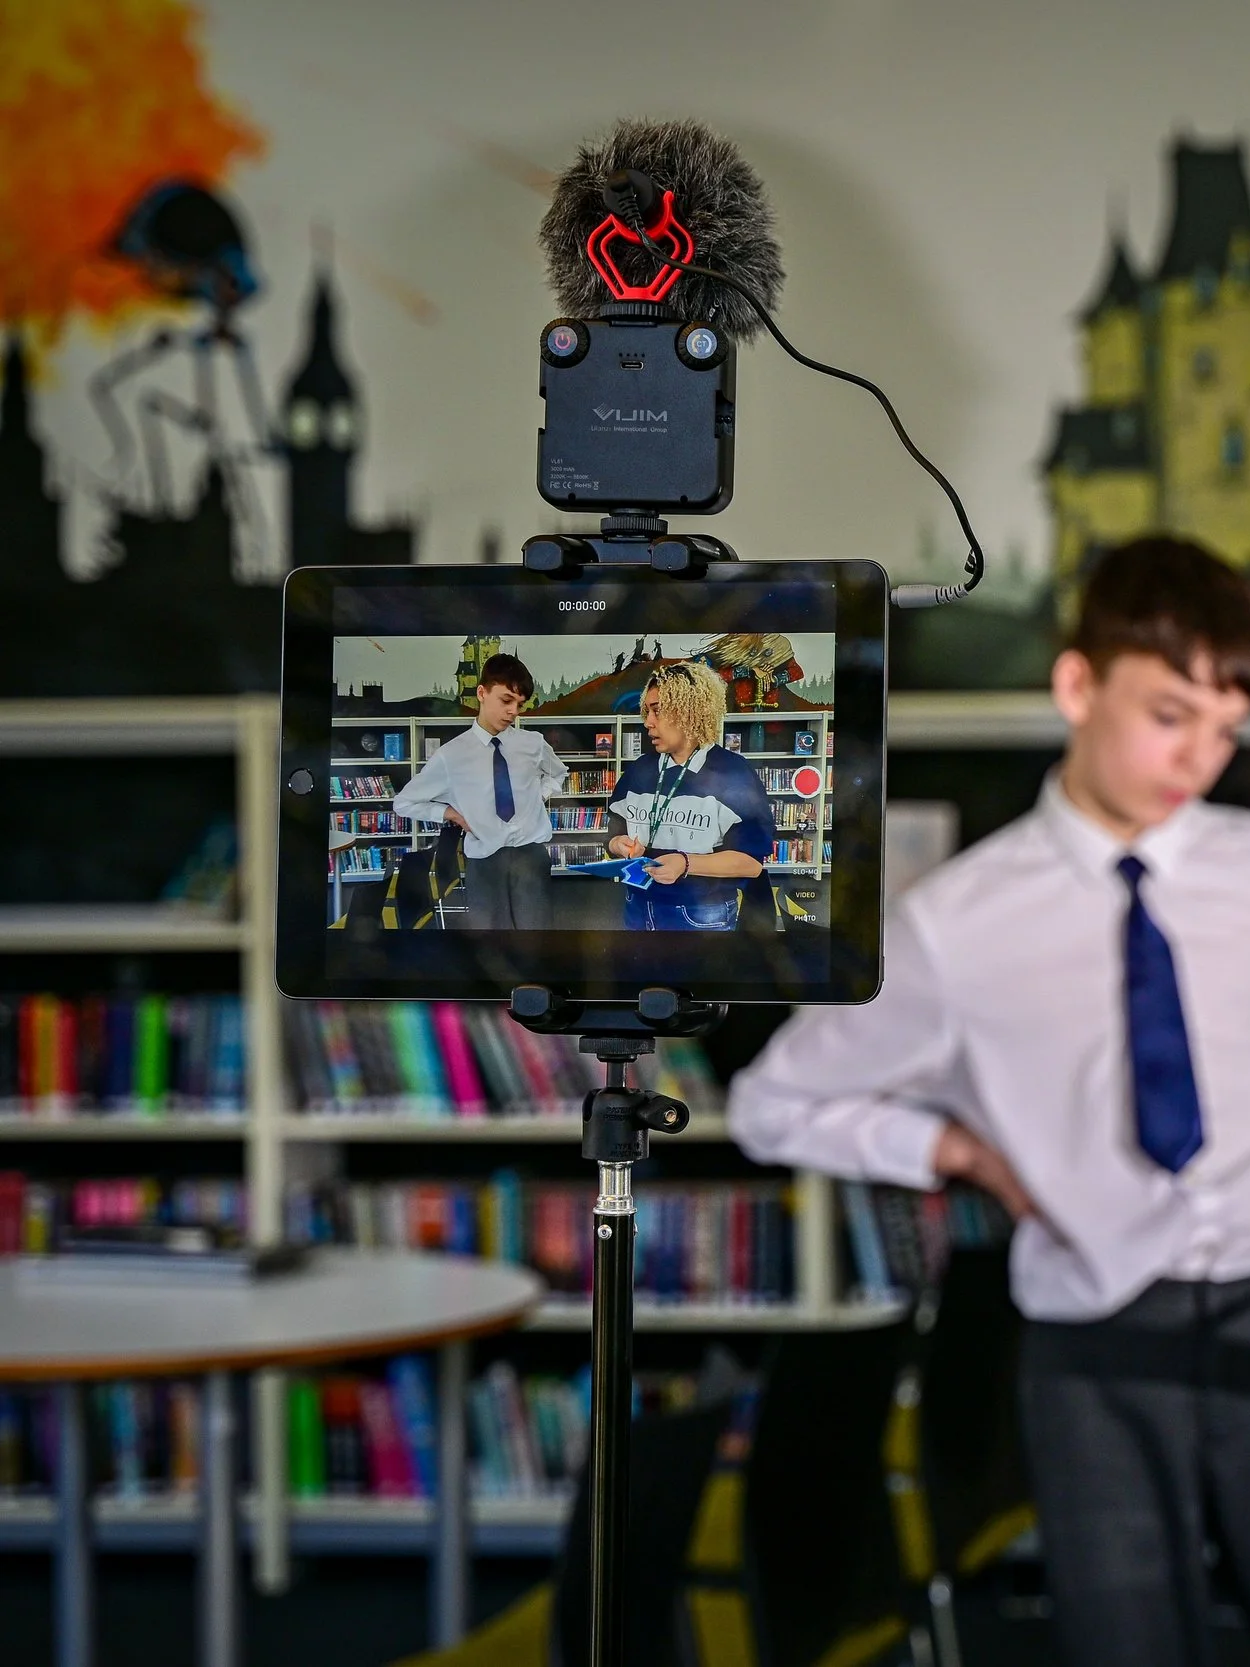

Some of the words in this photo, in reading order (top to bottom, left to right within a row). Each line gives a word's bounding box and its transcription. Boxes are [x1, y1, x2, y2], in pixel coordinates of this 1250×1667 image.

[696, 340, 707, 348] CT
[592, 403, 668, 422] VIJIM
[613, 425, 648, 433] International
[650, 426, 668, 434] Group
[558, 600, 606, 611] 00:00:00
